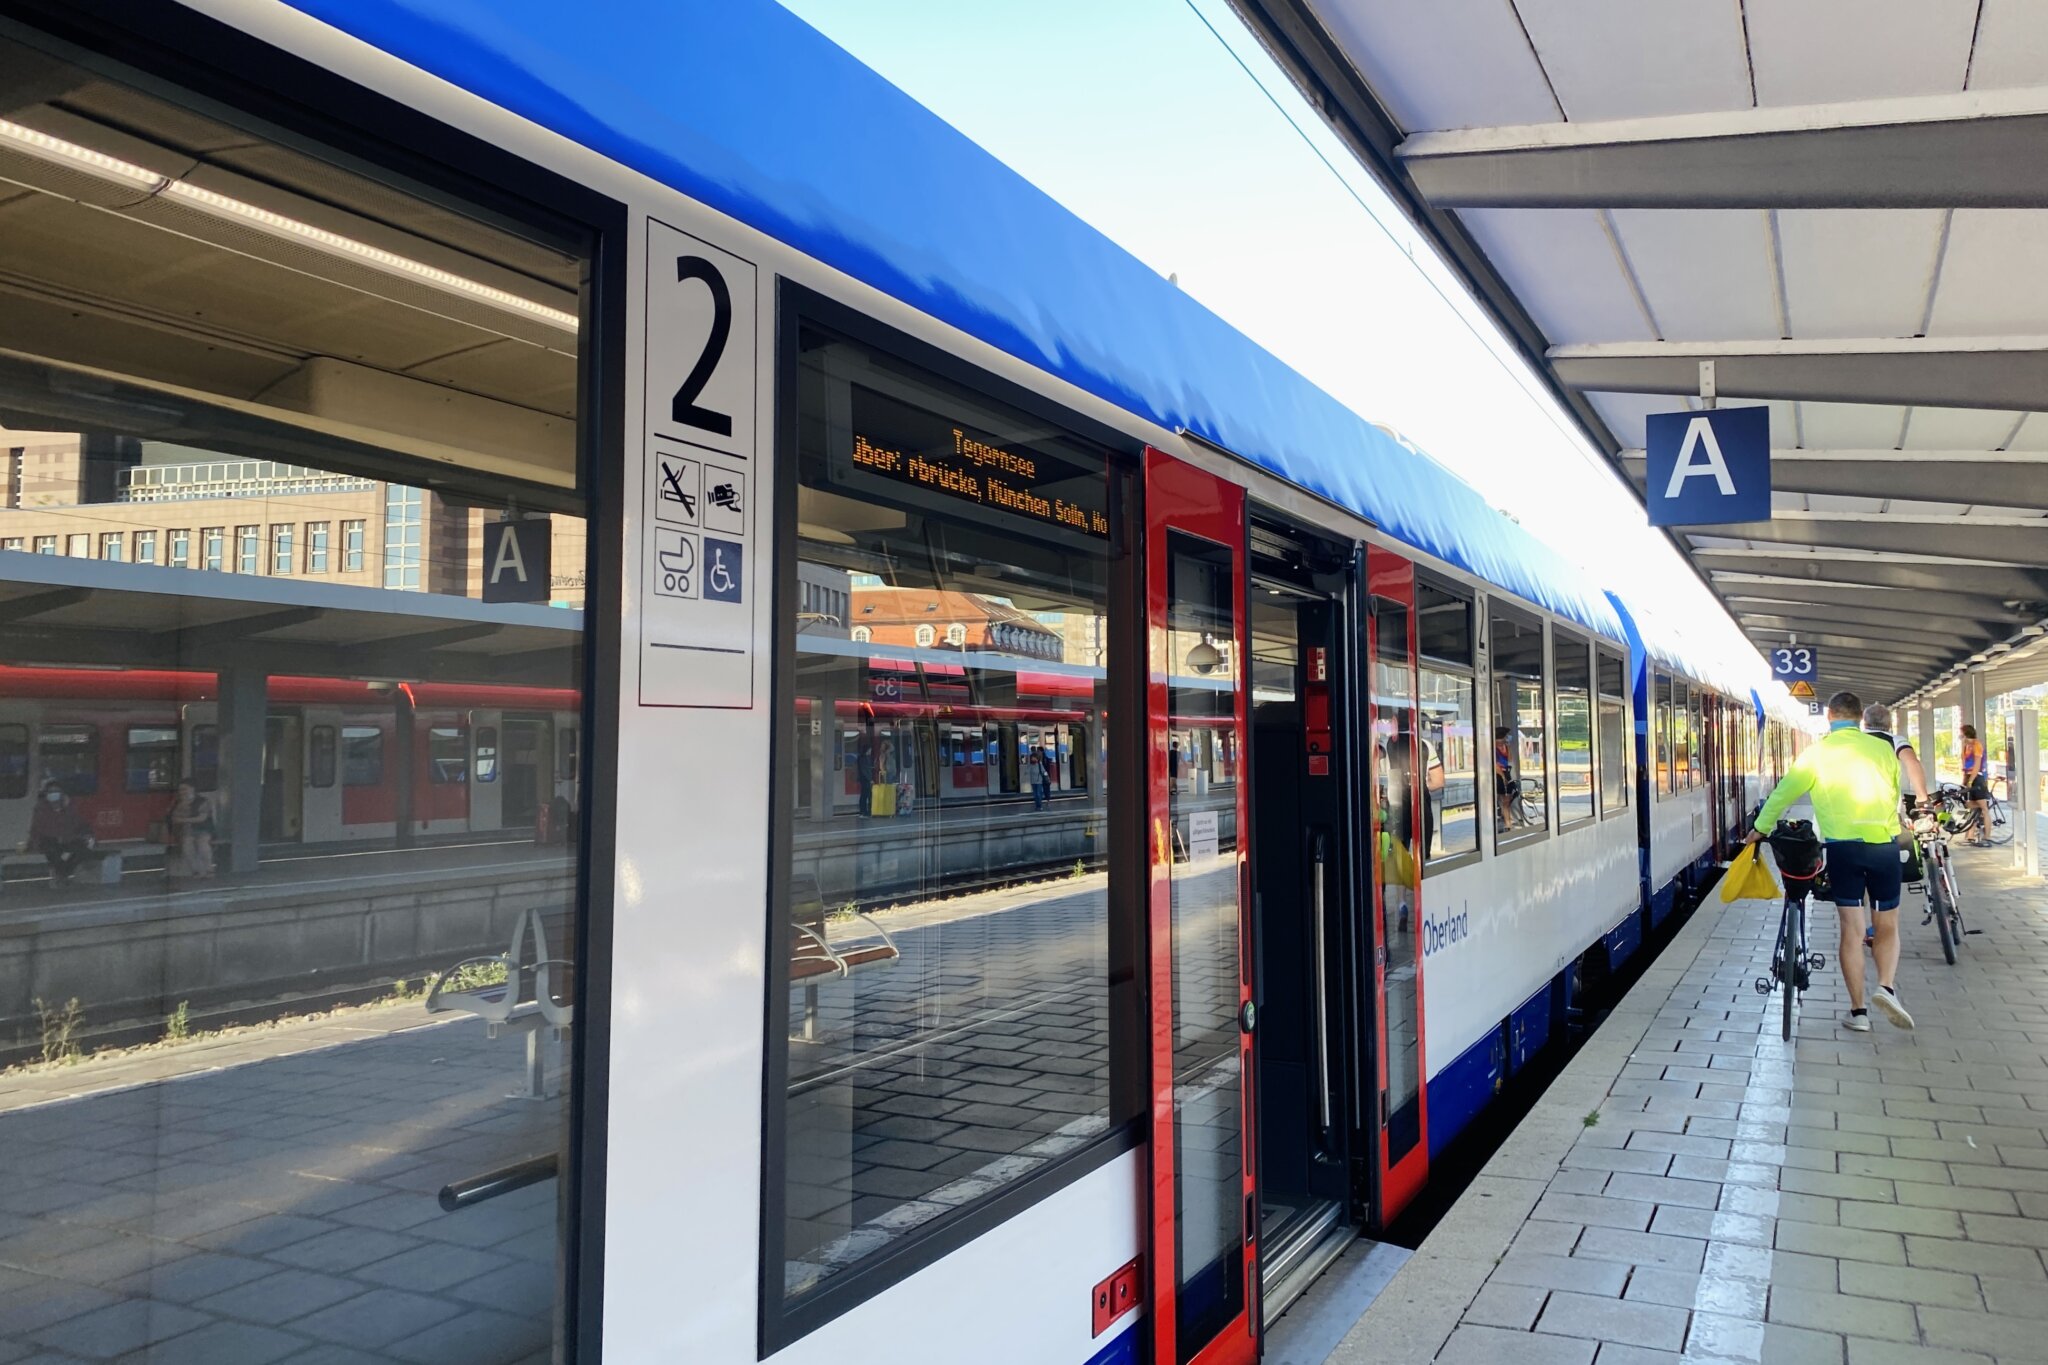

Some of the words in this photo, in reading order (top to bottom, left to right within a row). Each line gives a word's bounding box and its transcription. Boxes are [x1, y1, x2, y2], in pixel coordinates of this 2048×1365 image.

[672, 255, 732, 438] 2
[953, 429, 1035, 479] Tegernsee
[1664, 416, 1737, 499] A
[909, 455, 982, 503] rbrücke,
[988, 477, 1050, 518] München
[1056, 498, 1088, 534] Solln,
[1093, 510, 1108, 534] Ho
[1478, 595, 1485, 650] 2
[1775, 649, 1812, 674] 33
[1810, 702, 1819, 713] B
[1423, 899, 1468, 957] Oberland
